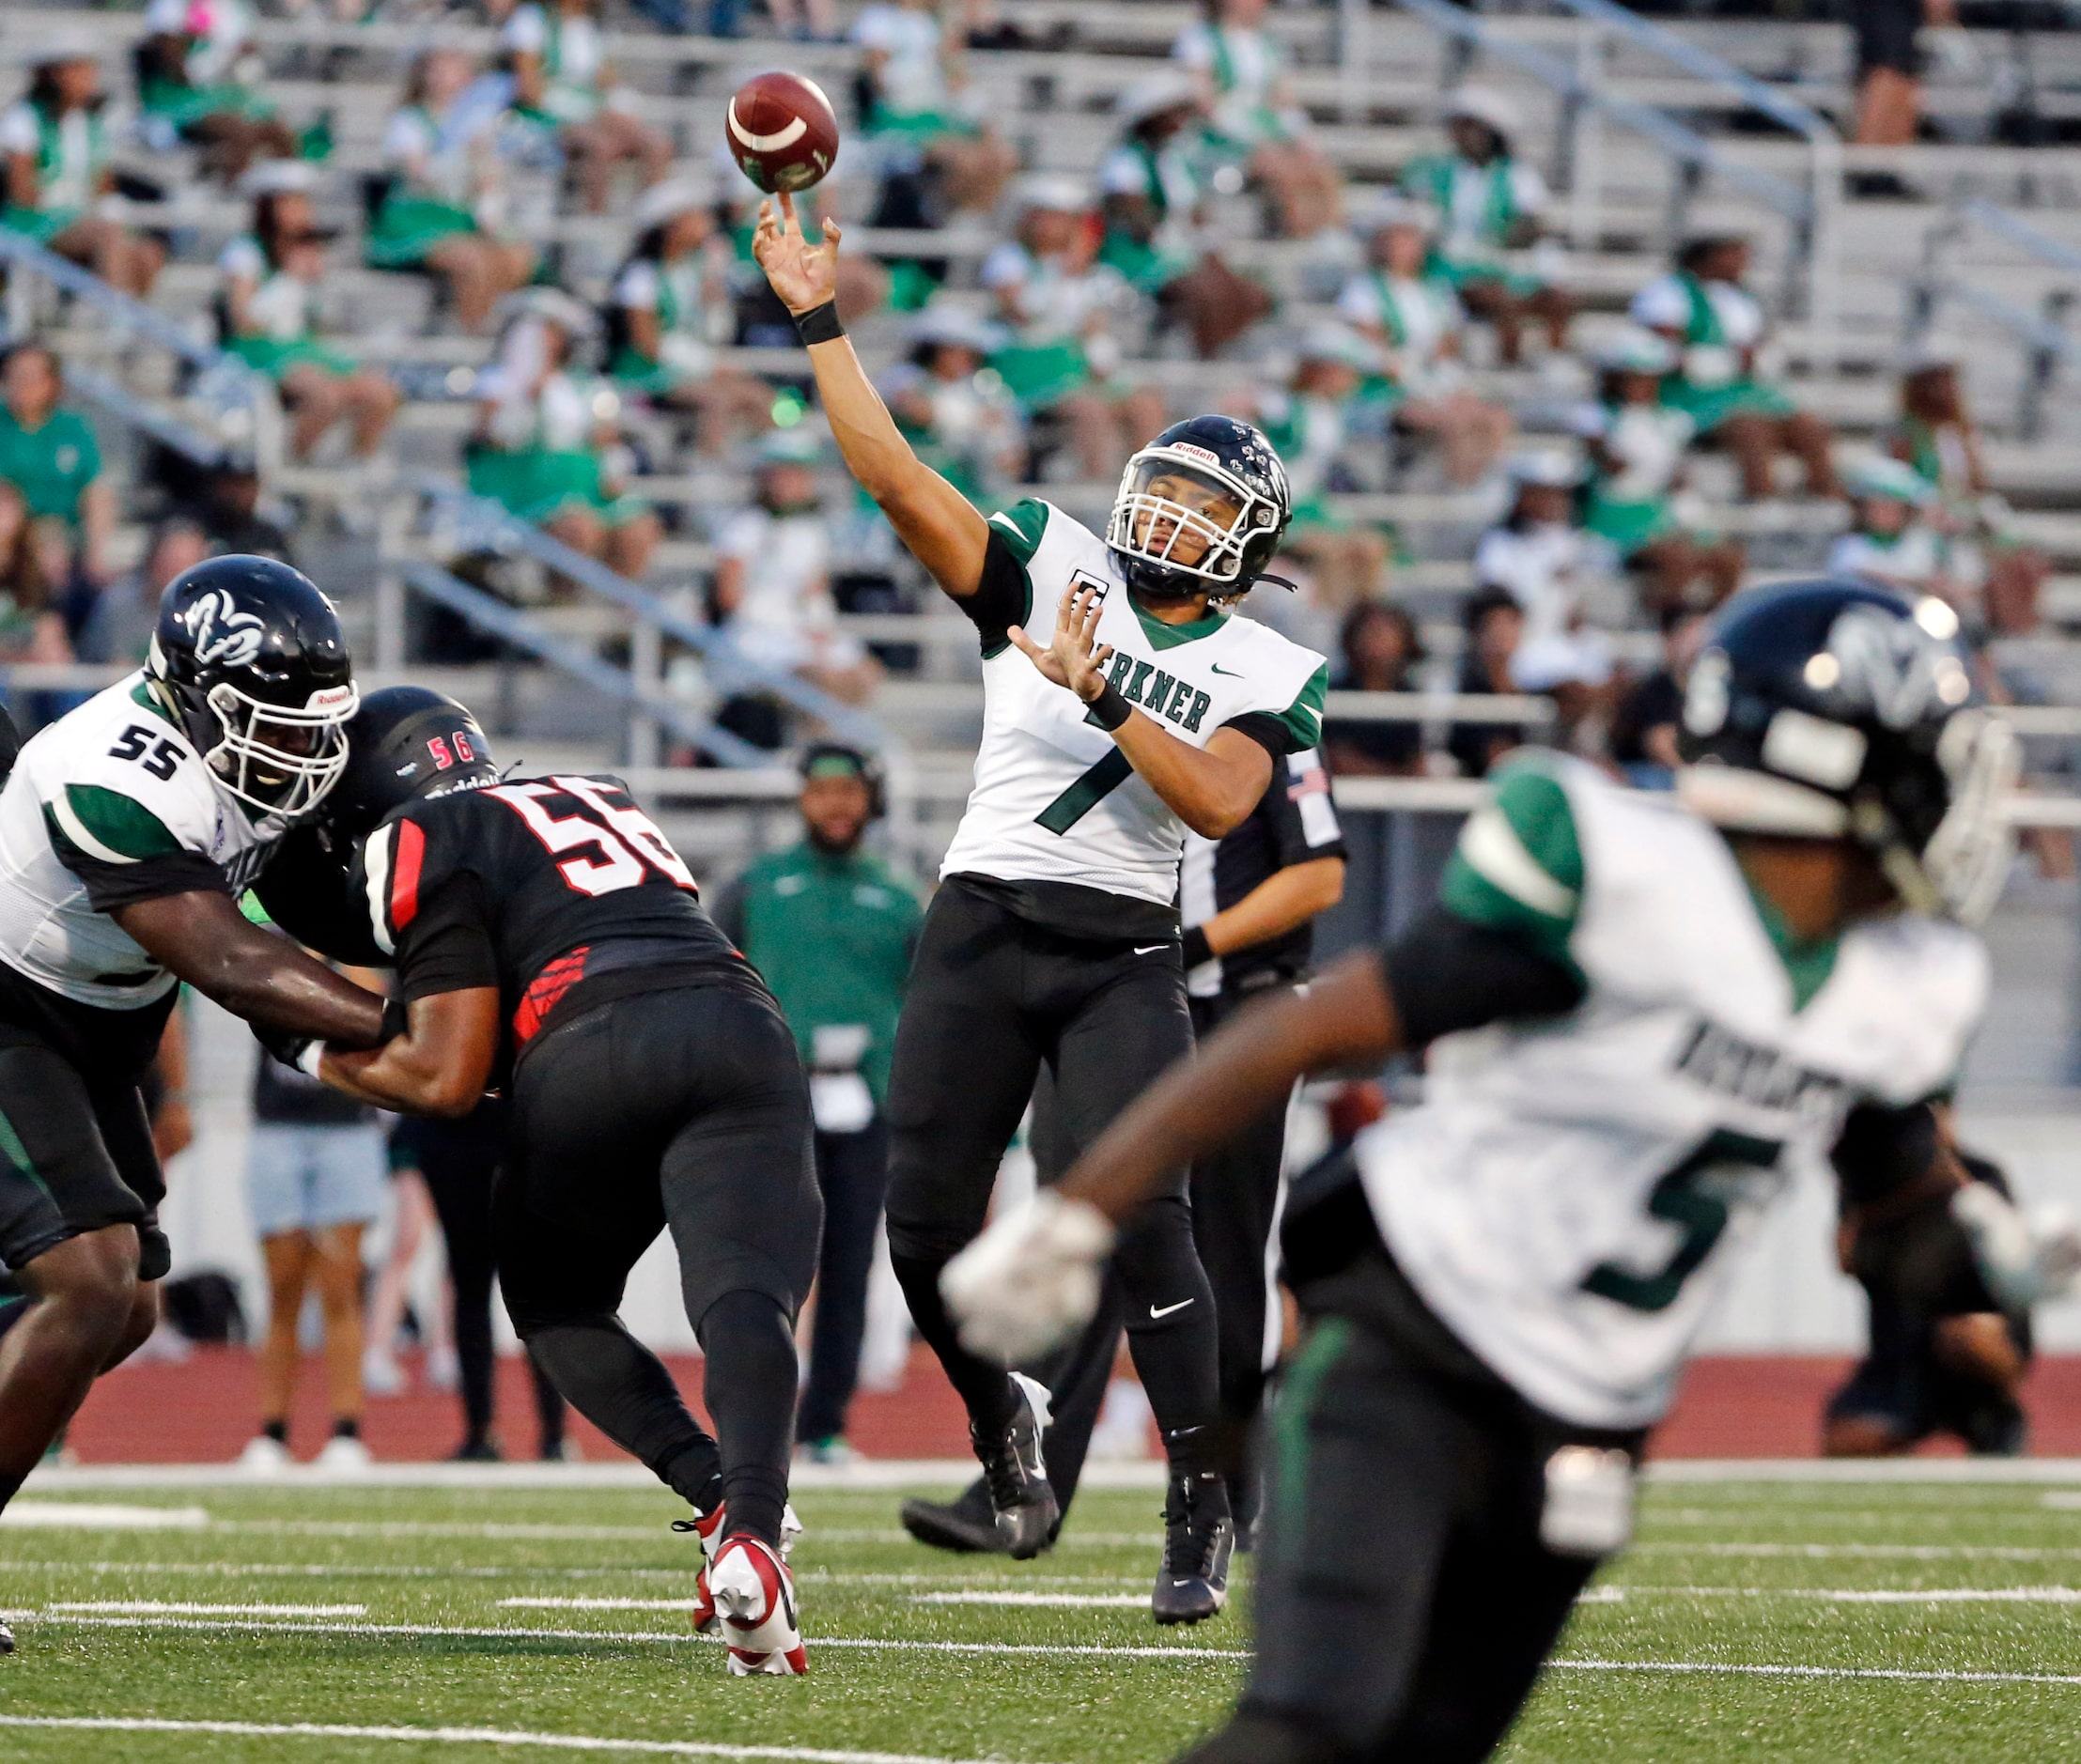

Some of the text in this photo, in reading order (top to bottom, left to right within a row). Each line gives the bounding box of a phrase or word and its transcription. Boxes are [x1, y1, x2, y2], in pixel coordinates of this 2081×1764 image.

[1174, 442, 1215, 461] Riddell
[1089, 641, 1212, 735] RKNER
[107, 723, 188, 781] 55
[427, 731, 475, 770] 56
[425, 774, 502, 799] ddell
[477, 775, 699, 898] 56
[1576, 1125, 1787, 1313] 5
